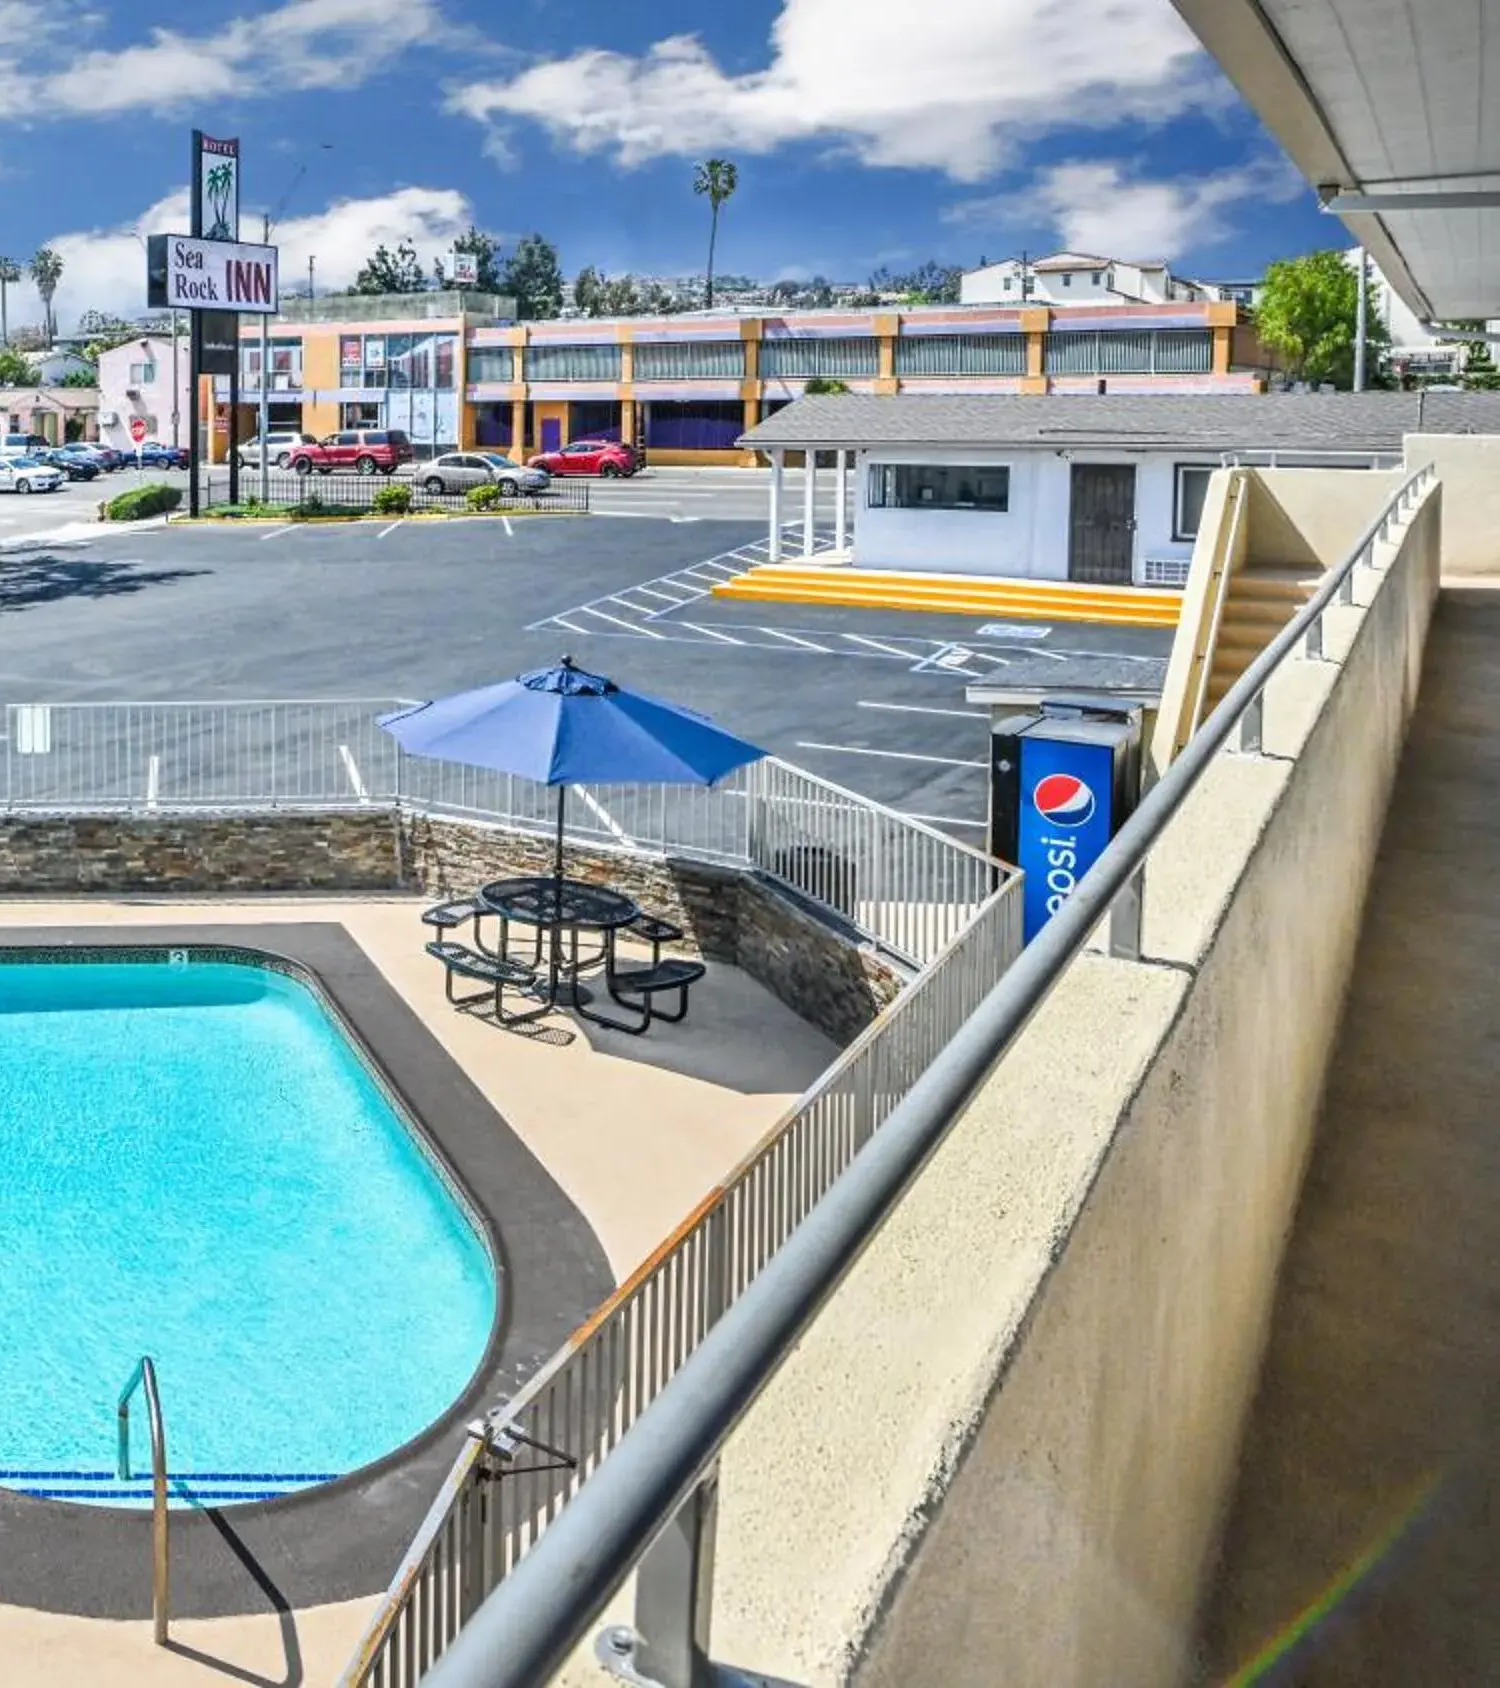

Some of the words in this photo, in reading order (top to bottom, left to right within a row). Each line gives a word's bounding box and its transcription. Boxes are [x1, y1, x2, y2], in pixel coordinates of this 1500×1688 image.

[175, 241, 203, 269] Sea
[174, 273, 218, 301] Rock
[225, 260, 271, 304] INN
